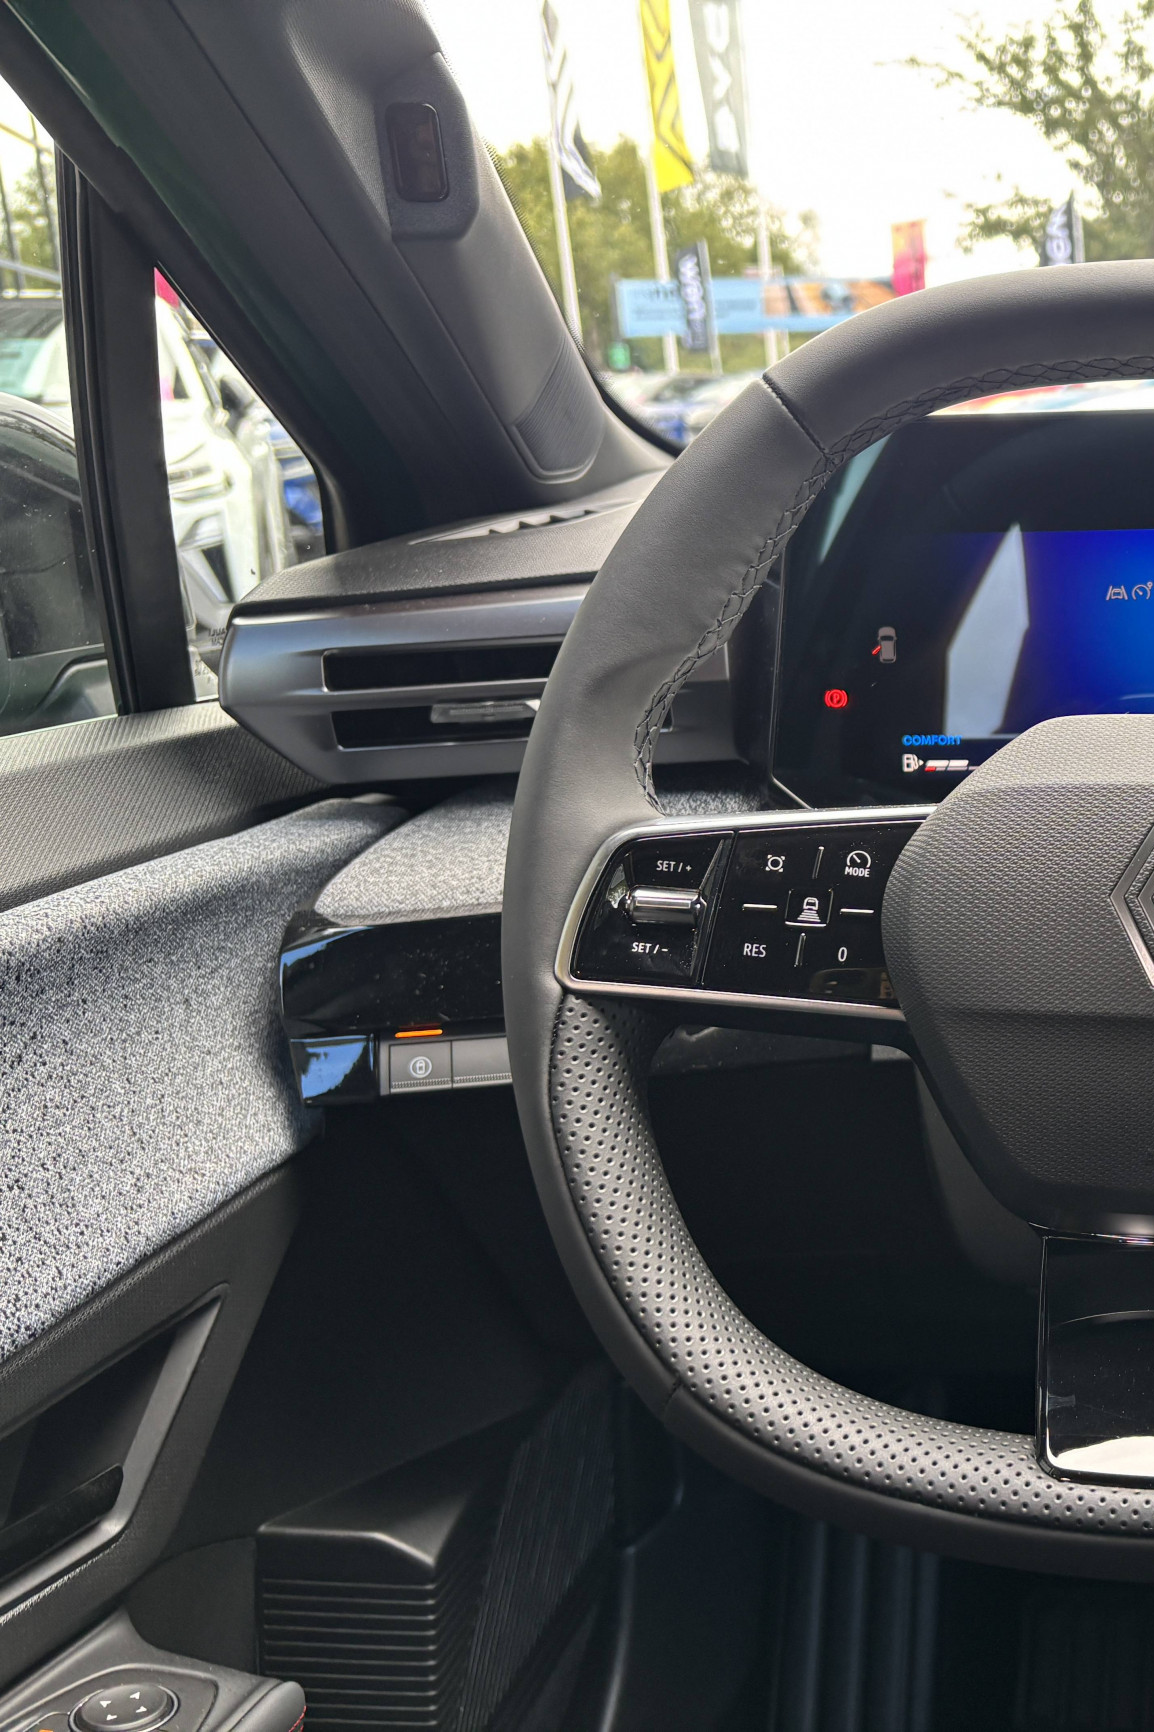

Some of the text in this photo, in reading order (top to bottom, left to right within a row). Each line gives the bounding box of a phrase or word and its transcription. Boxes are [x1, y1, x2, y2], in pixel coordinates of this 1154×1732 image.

[902, 734, 962, 746] COMFORT
[656, 860, 677, 872] SET
[845, 866, 870, 878] MODE
[631, 942, 652, 953] SET
[743, 943, 767, 958] RES
